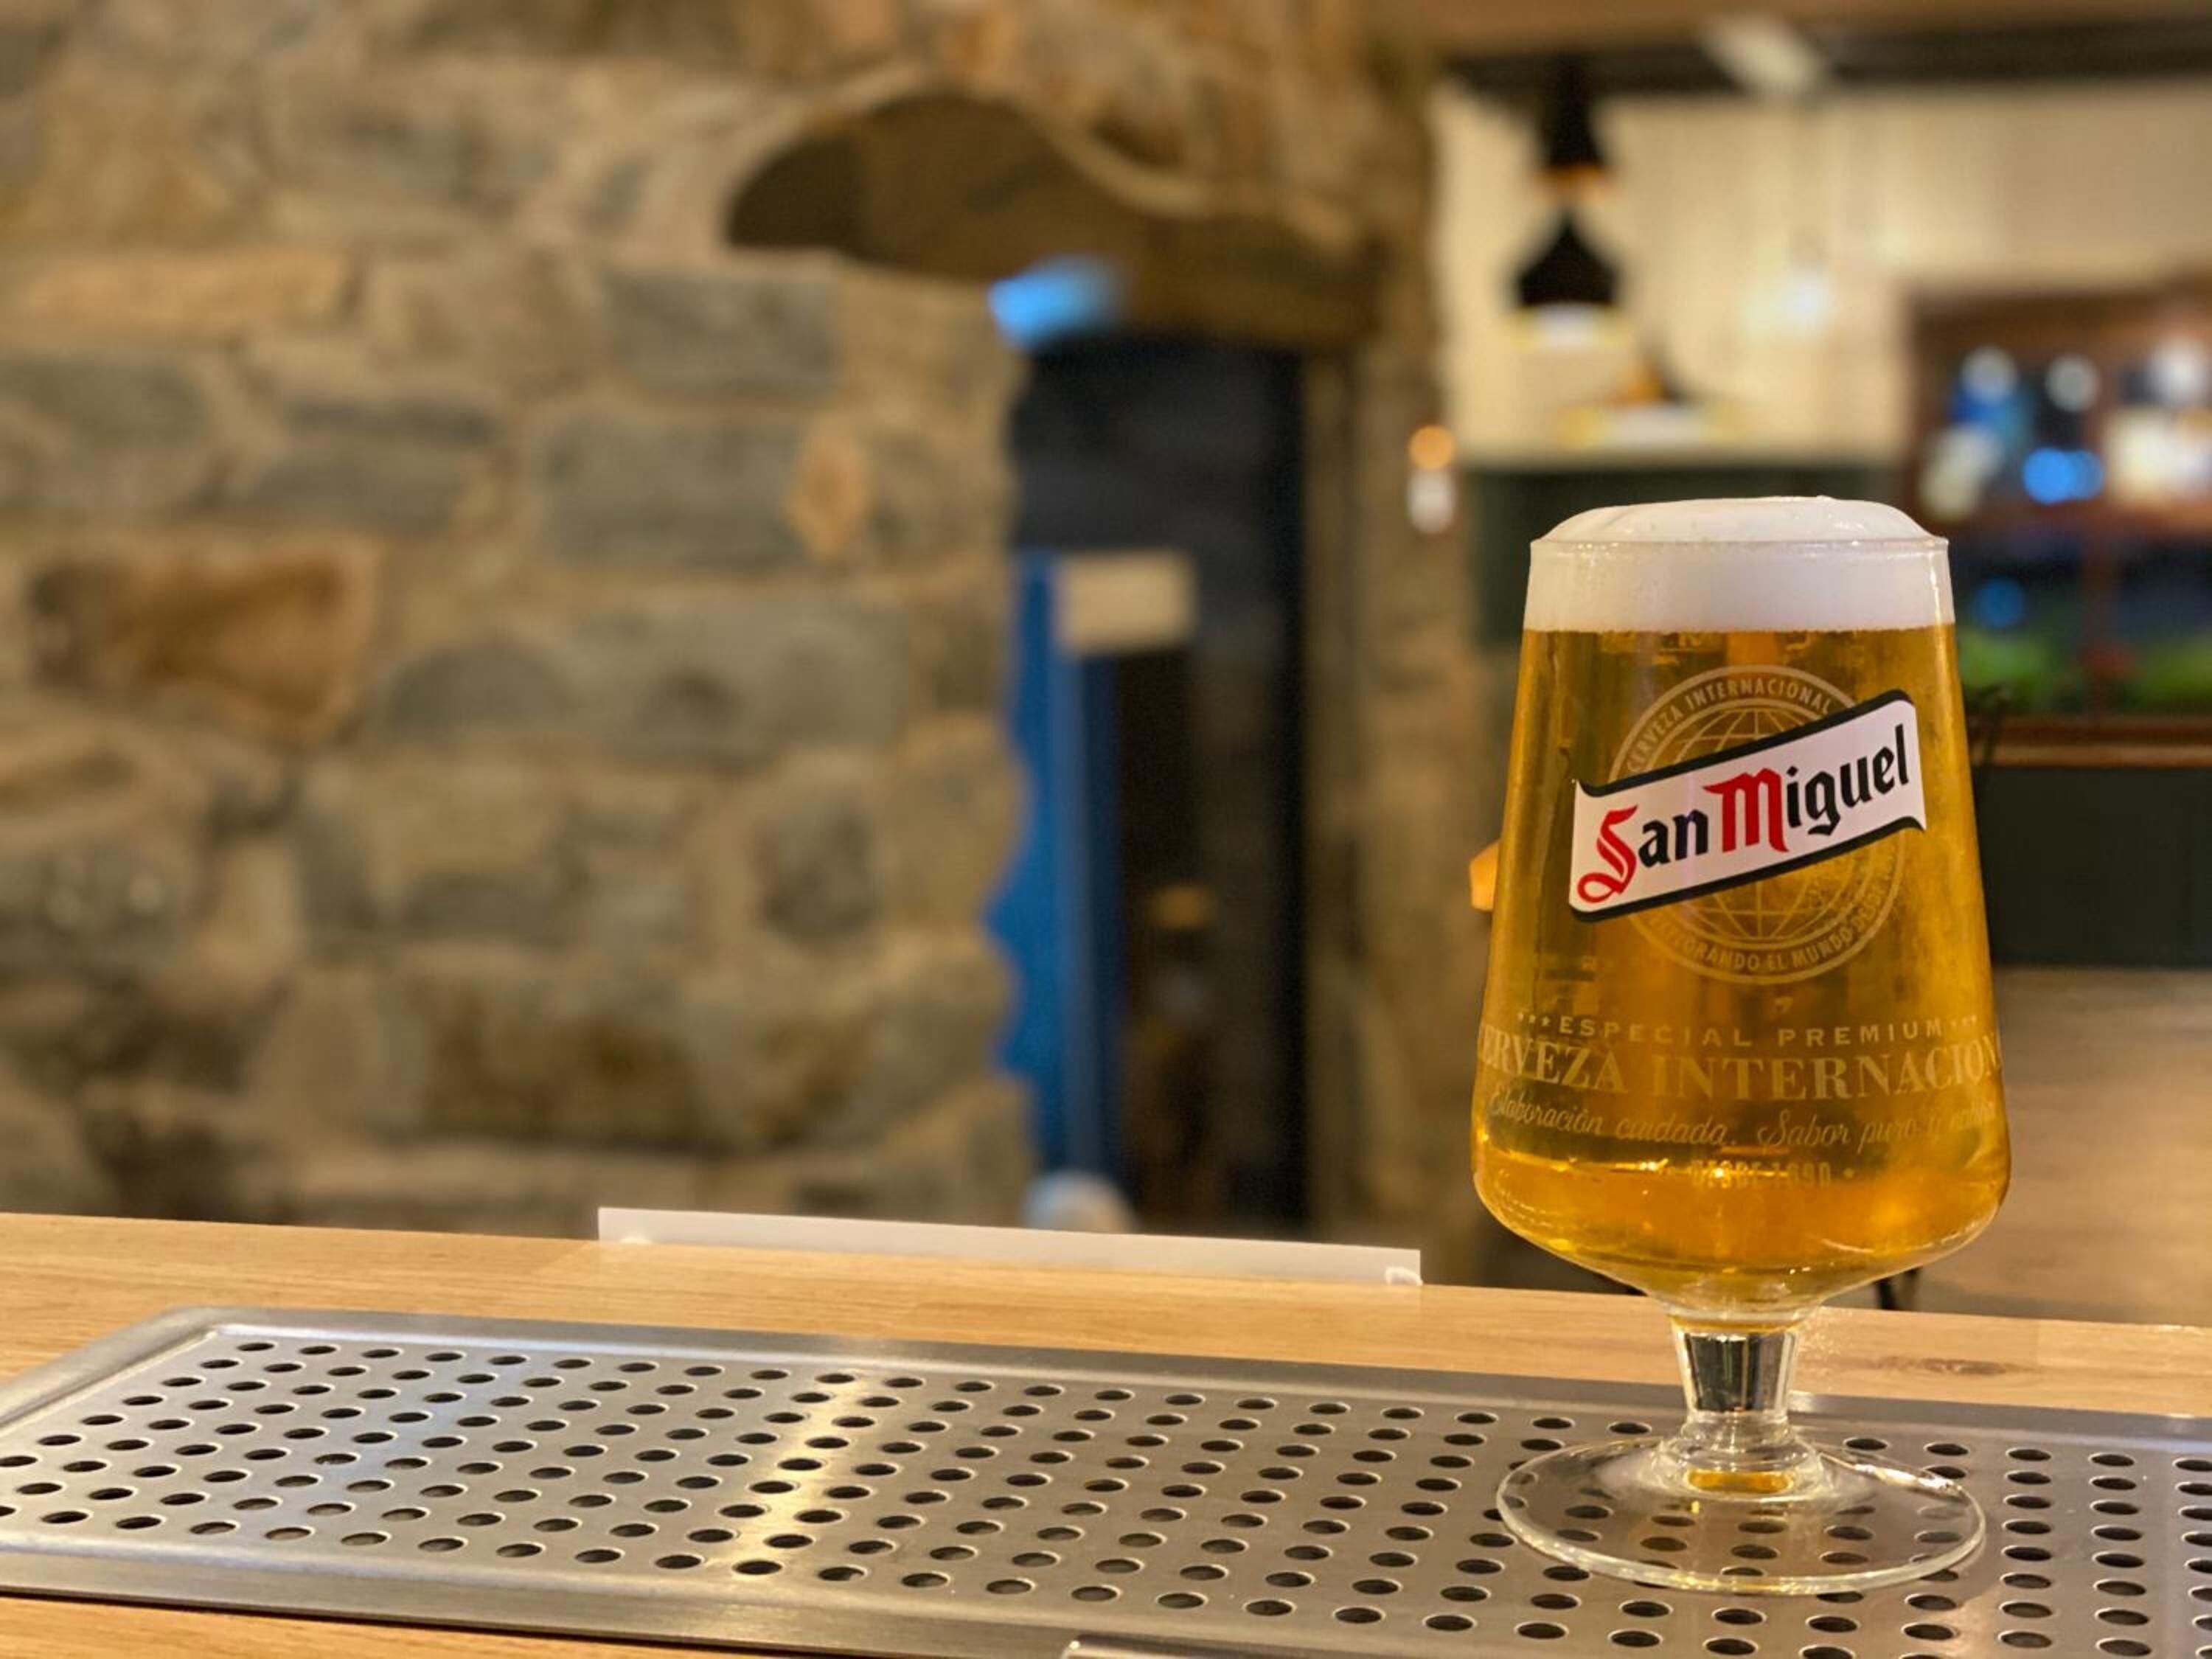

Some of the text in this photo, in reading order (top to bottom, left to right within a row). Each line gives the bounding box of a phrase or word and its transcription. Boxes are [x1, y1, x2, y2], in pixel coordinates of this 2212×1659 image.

[1627, 678, 1830, 772] CERVEZA INTERNACIONAL
[1576, 723, 1910, 904] San Miguel
[1768, 955, 1788, 970] EL
[1792, 925, 1854, 968] MUNDO
[1478, 1024, 1629, 1095] ERVEZA
[1559, 1015, 1943, 1048] ESPECIAL PREMIUM
[1757, 1108, 1852, 1147] Sabor
